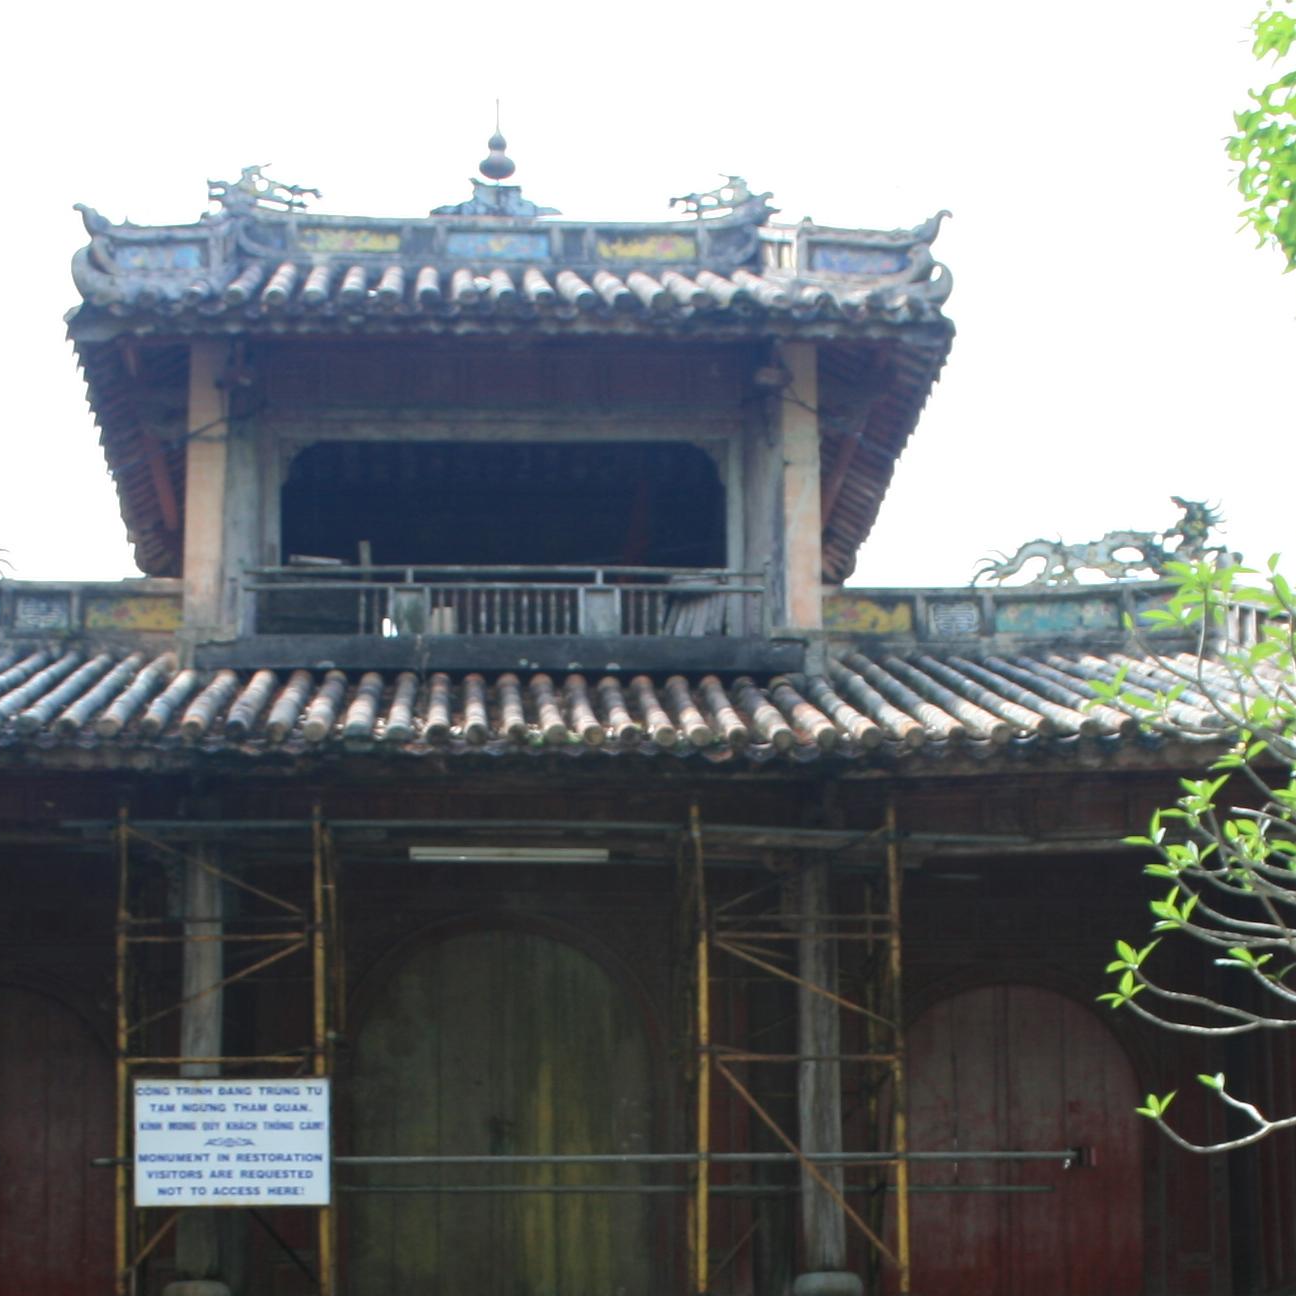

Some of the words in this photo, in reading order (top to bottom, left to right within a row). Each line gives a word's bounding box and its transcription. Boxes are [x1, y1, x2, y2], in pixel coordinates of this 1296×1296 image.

[139, 1153, 210, 1162] MONUMENT
[217, 1153, 230, 1162] IN
[236, 1153, 323, 1162] RESTORATION
[146, 1170, 203, 1179] VISITORS
[209, 1170, 233, 1179] ARE
[240, 1170, 314, 1179] REQUESTED
[157, 1186, 183, 1196] NOT
[190, 1186, 207, 1196] TO
[212, 1186, 261, 1196] ACCESS
[267, 1186, 305, 1196] HERE!
